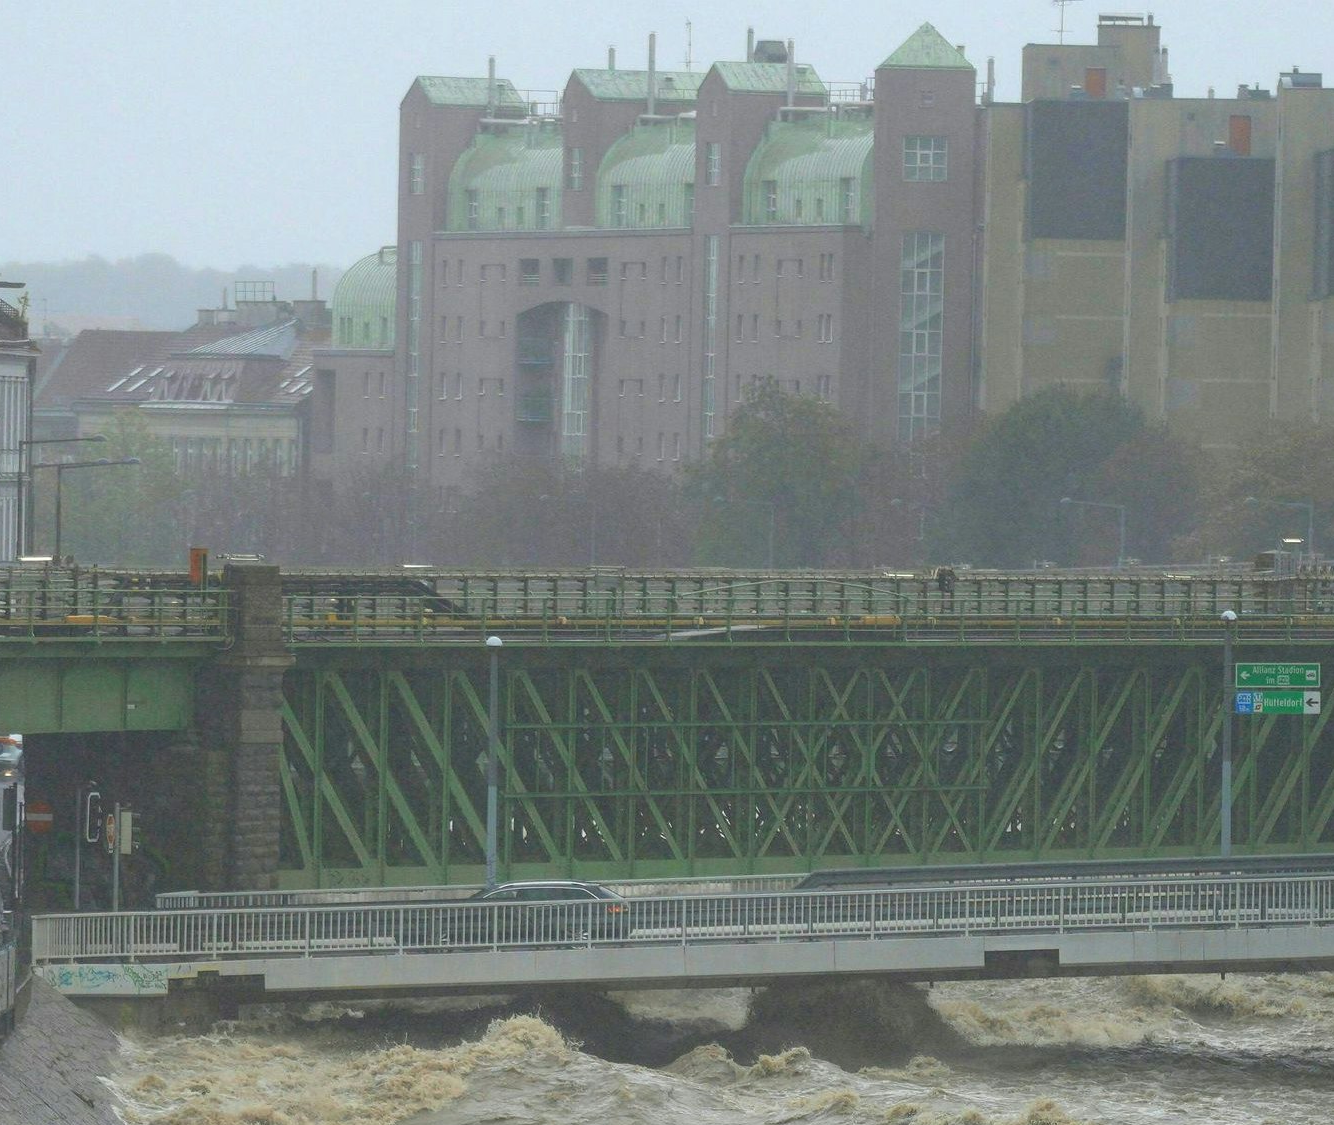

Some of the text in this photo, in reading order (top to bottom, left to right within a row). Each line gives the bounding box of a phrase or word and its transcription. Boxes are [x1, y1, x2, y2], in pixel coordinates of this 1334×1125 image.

[1252, 665, 1304, 674] Allianz Stadion
[1266, 676, 1275, 684] im
[1264, 697, 1303, 707] Hütteldorf
